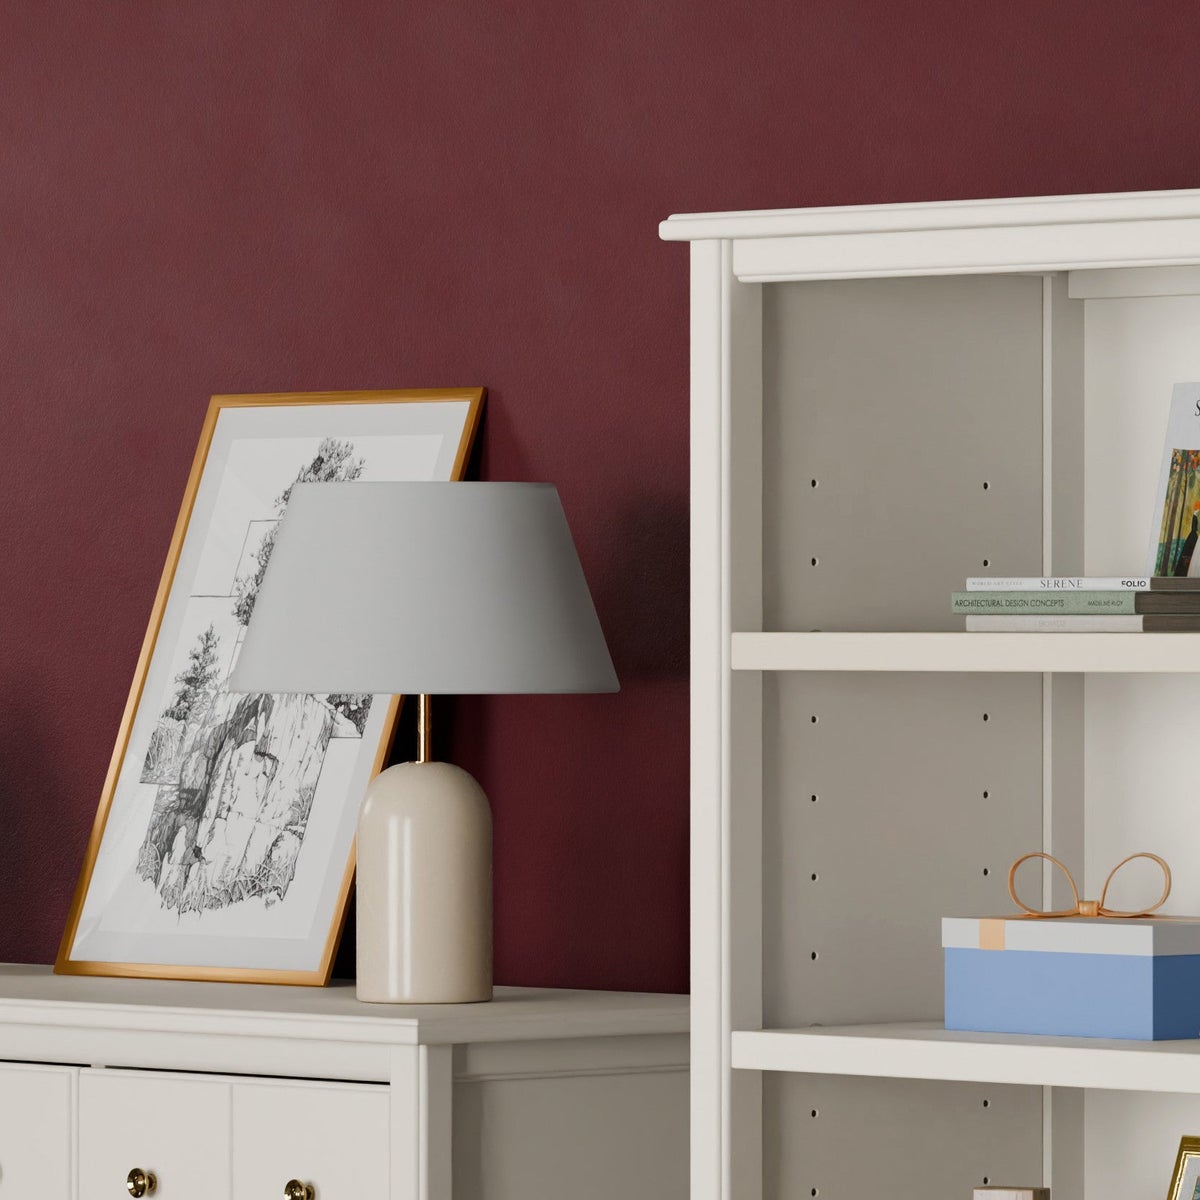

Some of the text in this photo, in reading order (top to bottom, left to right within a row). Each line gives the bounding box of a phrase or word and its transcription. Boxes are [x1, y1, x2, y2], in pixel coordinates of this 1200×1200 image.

[1040, 579, 1083, 588] SERENE
[954, 599, 1065, 607] ARCHITECTURAL DESIGN CONCEPTS
